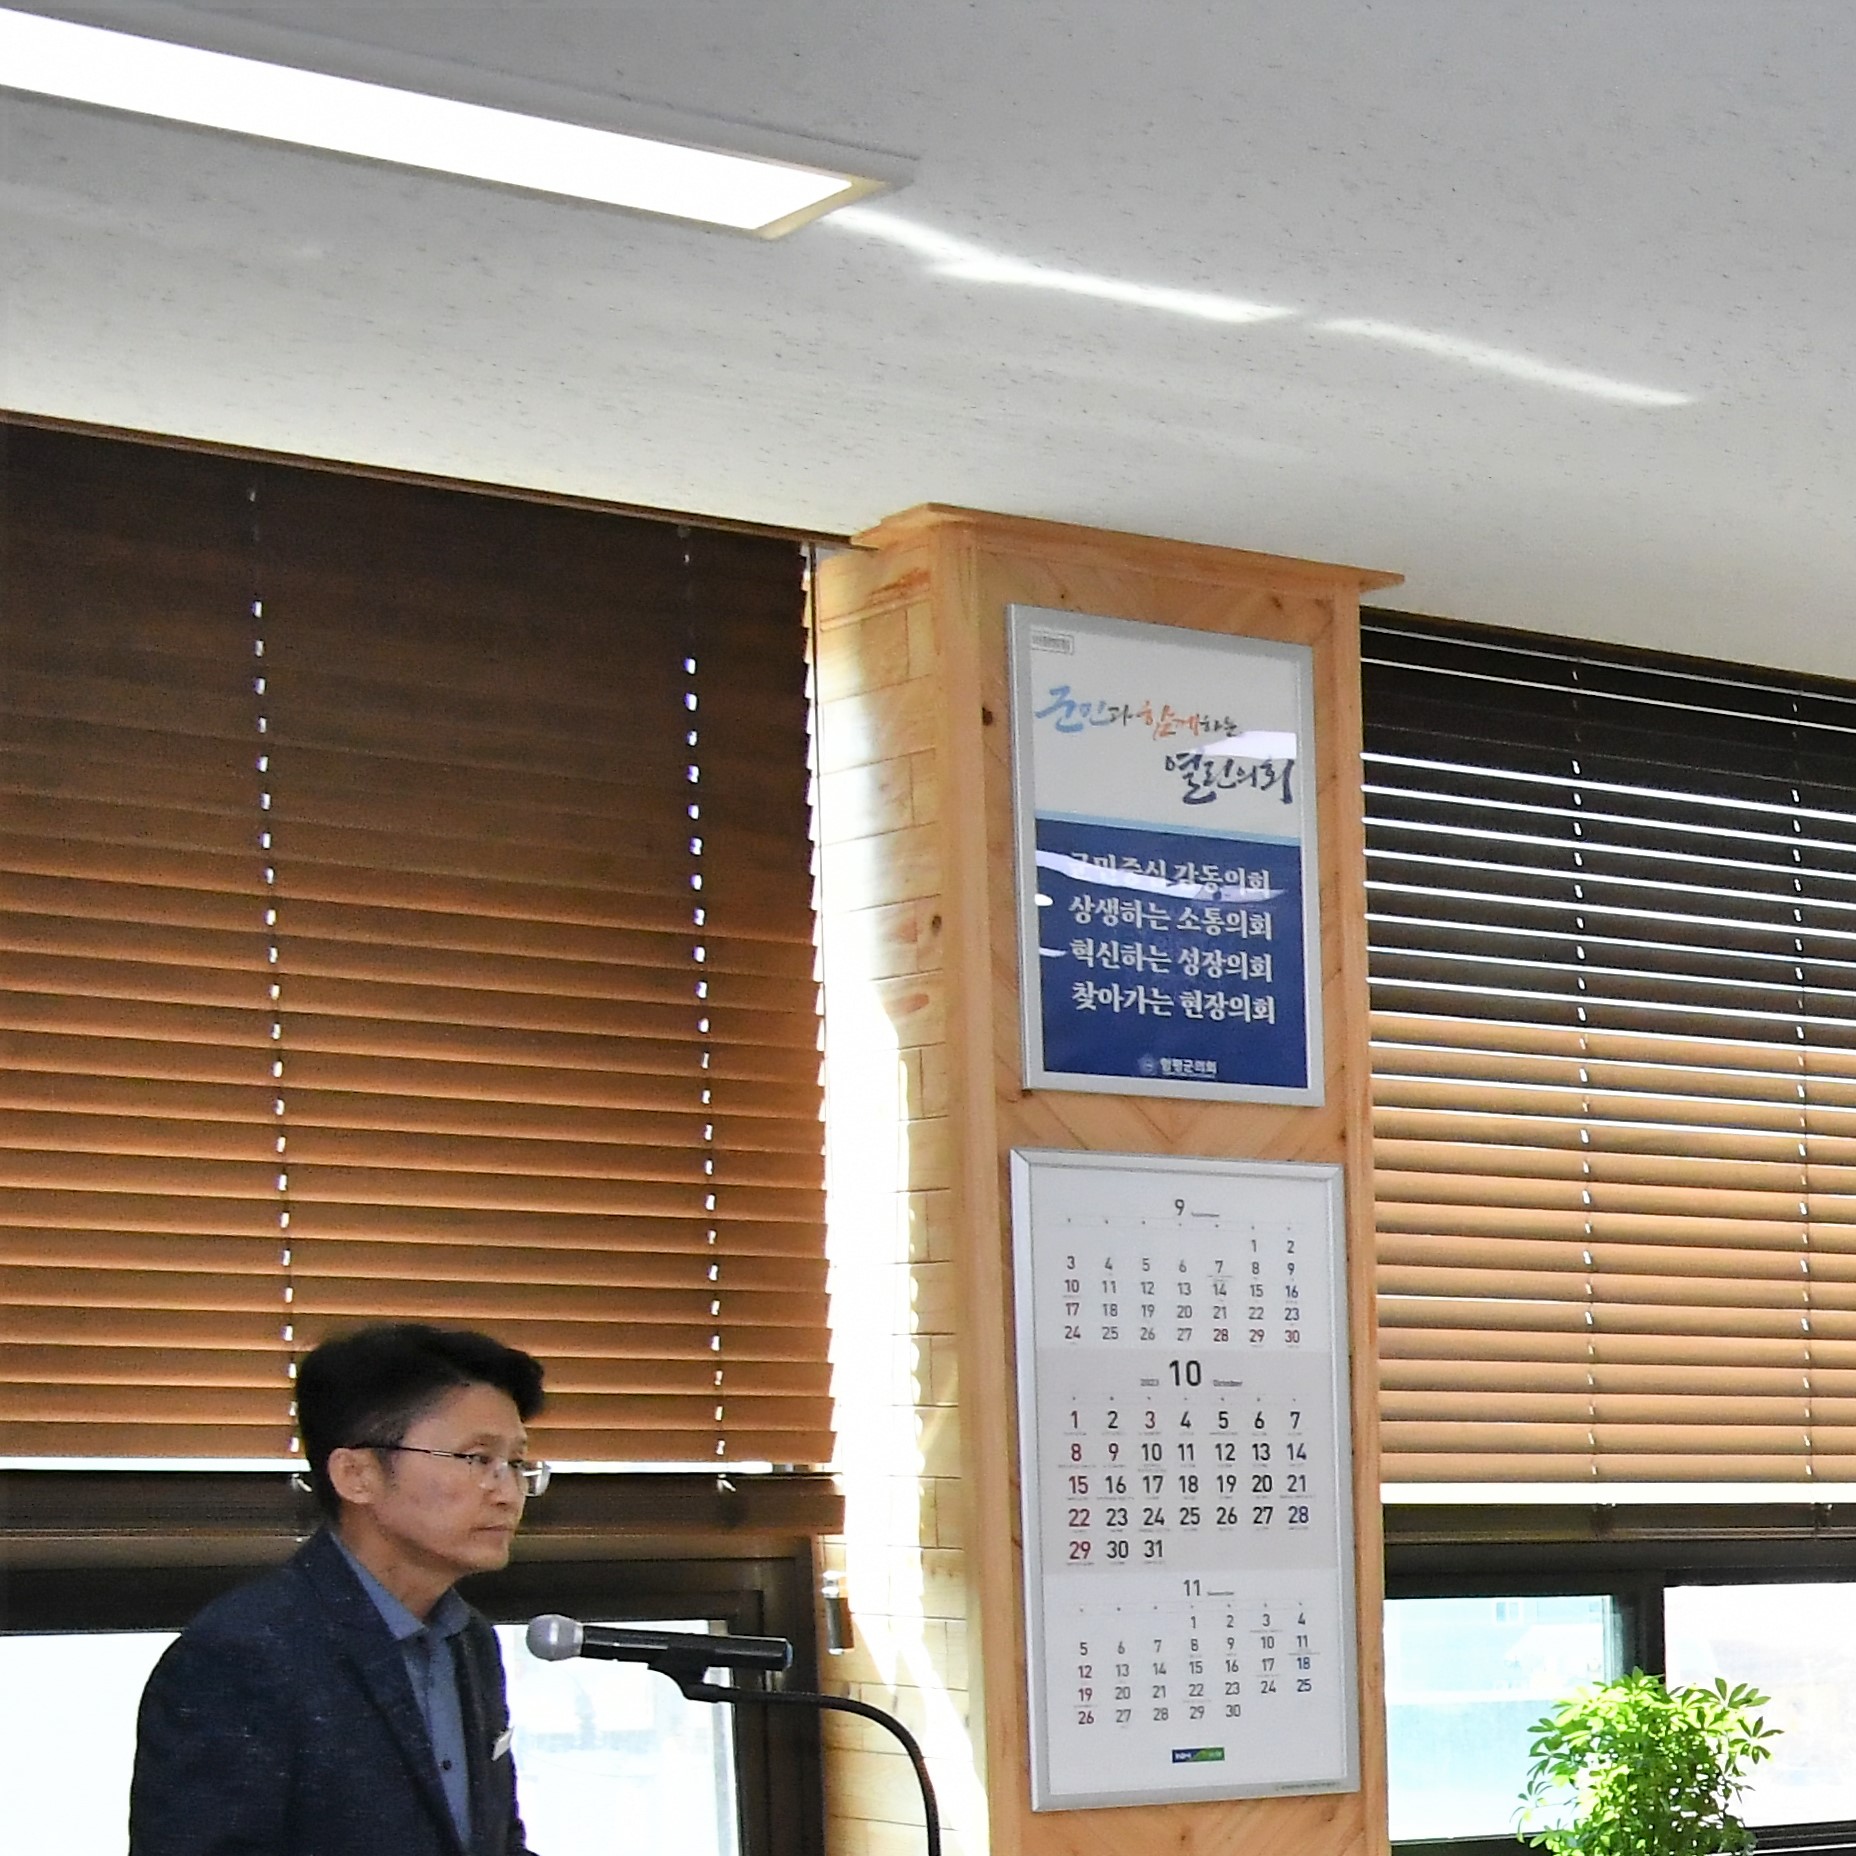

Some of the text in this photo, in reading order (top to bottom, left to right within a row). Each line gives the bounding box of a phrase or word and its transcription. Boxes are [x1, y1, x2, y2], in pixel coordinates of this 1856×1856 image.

[1164, 750, 1296, 806] 열린의회
[1068, 894, 1273, 941] 상생하는 소통의회
[1069, 937, 1274, 984] 혁신하는 성장의회
[1072, 980, 1277, 1026] 찾아가는 현장의회
[1174, 1198, 1185, 1216] 9
[1250, 1238, 1295, 1254] 1 2
[1066, 1255, 1295, 1276] 3 4 5 6 7 8 9
[1064, 1278, 1299, 1299] 10 11 12 13 14 15 16
[1065, 1302, 1300, 1322] 17 18 19 20 21 22 23
[1064, 1325, 1301, 1344] 24 25 26 27 28 29 30
[1169, 1359, 1202, 1387] 10
[1070, 1410, 1301, 1430] 1 2 3 4 5 6 7
[1070, 1442, 1307, 1462] 8 9 10 11 12 13 14
[1068, 1474, 1306, 1495] 15 16 17 18 19 20 21
[1068, 1505, 1309, 1528] 22 23 24 25 26 27 28
[1069, 1539, 1163, 1560] 29 30 31
[1183, 1579, 1201, 1597] 11
[1190, 1612, 1306, 1630] 1 2 3 4
[1079, 1634, 1308, 1656] 5 6 7 8 9 10 11
[1077, 1656, 1311, 1679] 12 13 14 15 16 17 18
[1077, 1678, 1312, 1702] 19 20 21 22 23 24 25
[1077, 1703, 1242, 1725] 26 27 28 29 30
